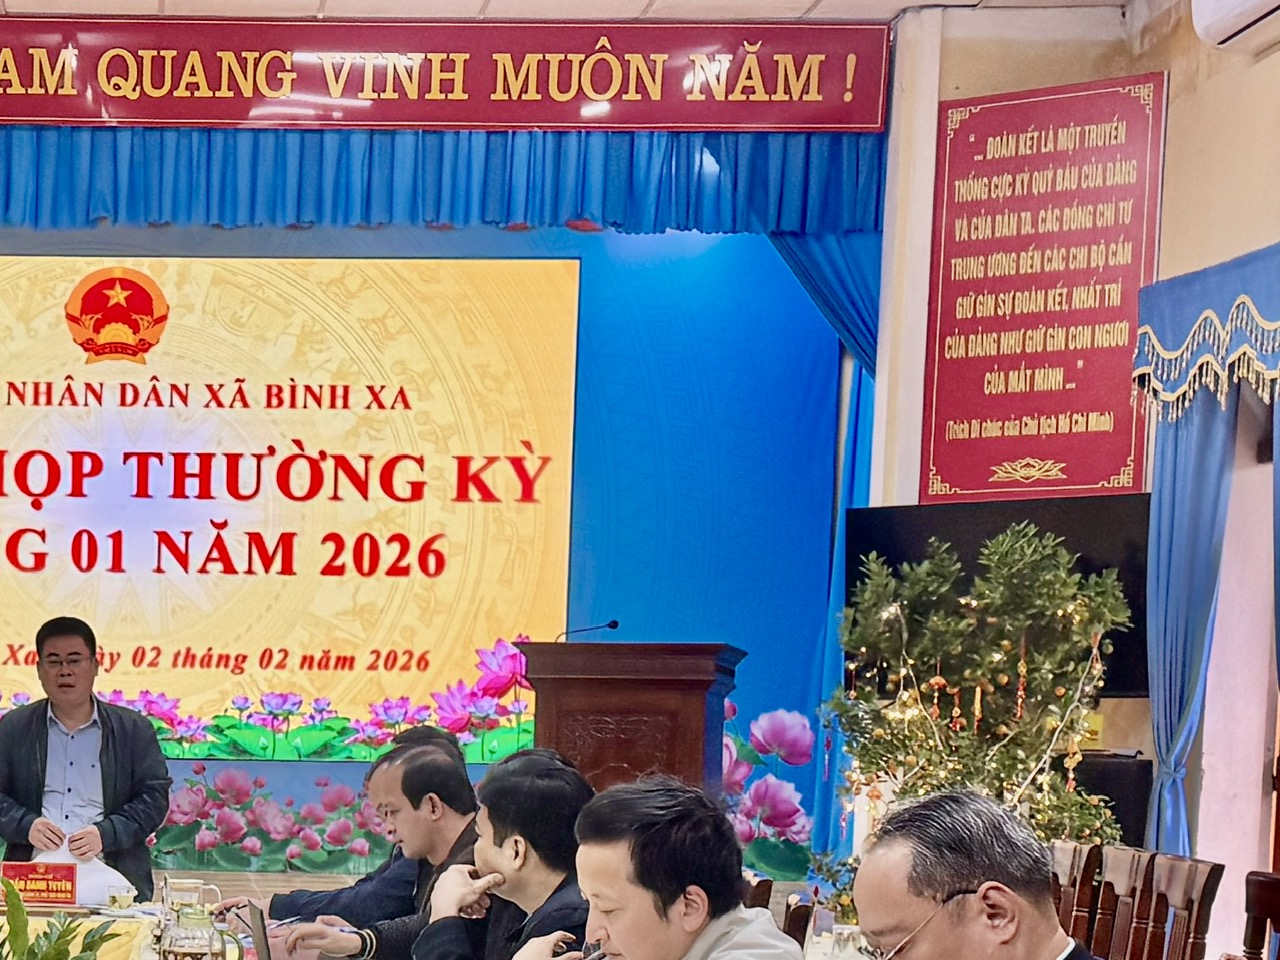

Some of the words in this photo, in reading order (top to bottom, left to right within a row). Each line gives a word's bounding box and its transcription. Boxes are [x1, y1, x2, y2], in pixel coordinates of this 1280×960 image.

[97, 48, 298, 100] QUANG
[319, 52, 470, 100] VINH
[491, 36, 669, 102] MUÔN
[686, 40, 826, 102] NĂM
[6, 374, 104, 407] NHÂN
[118, 375, 190, 408] DÂN
[203, 378, 251, 409] XÃ
[264, 377, 351, 410] BÌNH
[364, 385, 412, 410] XA
[122, 438, 428, 503] THƯỜNG
[451, 440, 552, 504] KỲ
[70, 529, 126, 574] 01
[152, 519, 299, 577] NĂM
[320, 532, 448, 579] 2026
[97, 645, 121, 673] ày
[131, 646, 162, 668] 02
[172, 647, 248, 675] tháng
[259, 648, 289, 670] 02
[299, 649, 355, 671] năm
[366, 650, 431, 672] 2026
